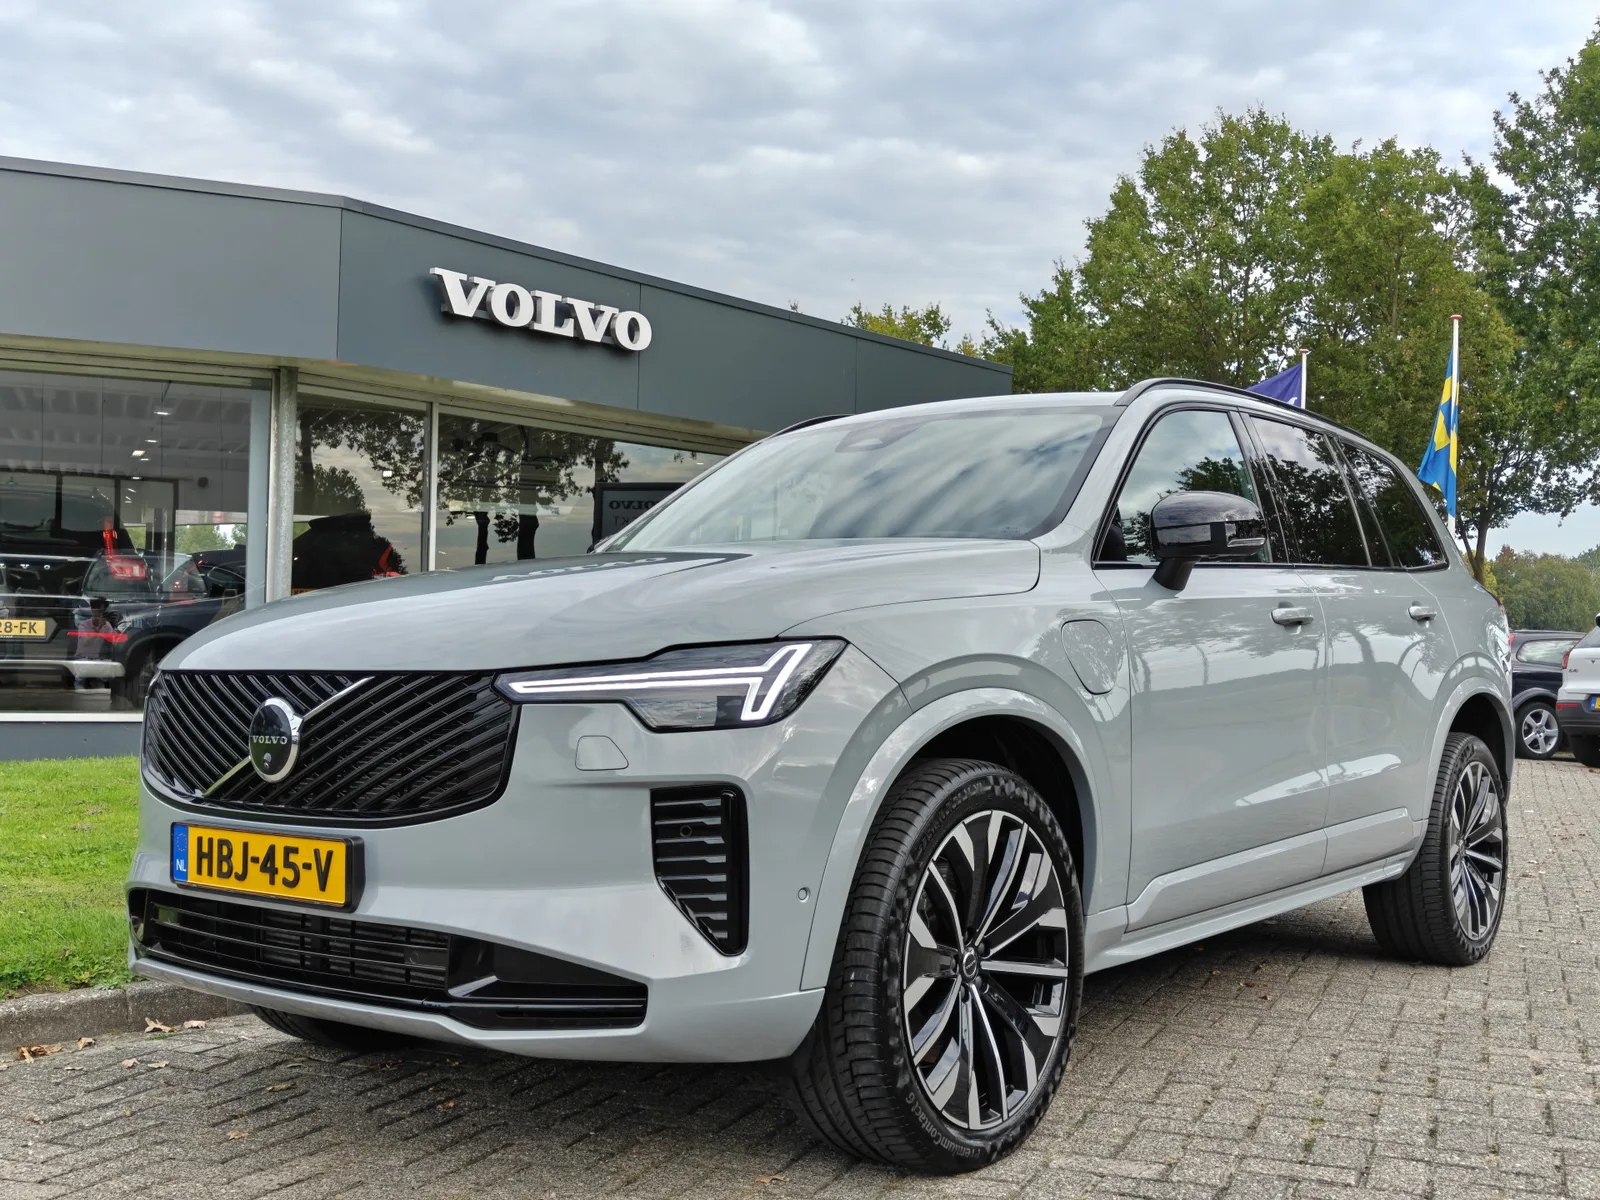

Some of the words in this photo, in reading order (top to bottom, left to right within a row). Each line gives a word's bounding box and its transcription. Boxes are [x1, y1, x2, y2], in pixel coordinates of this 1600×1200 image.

[429, 267, 652, 351] VOLVO
[251, 735, 288, 745] VOLVO
[175, 858, 187, 873] NL
[196, 835, 334, 893] HBJ-45-V
[905, 1091, 916, 1104] 6
